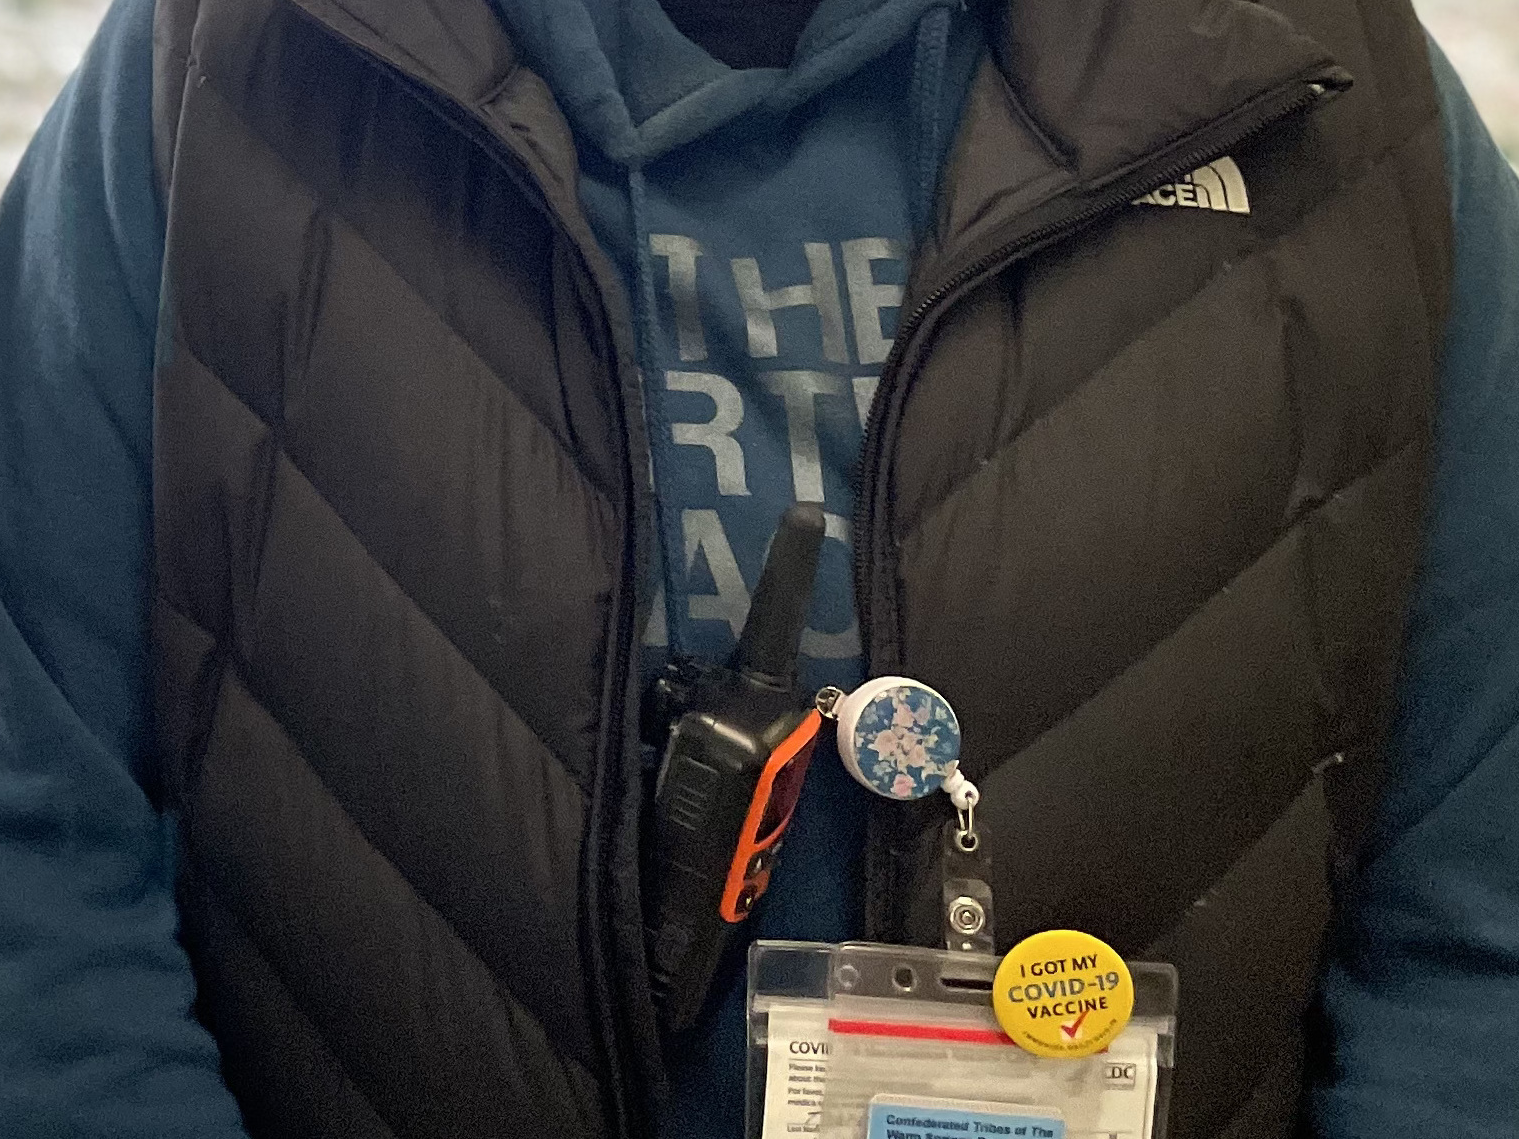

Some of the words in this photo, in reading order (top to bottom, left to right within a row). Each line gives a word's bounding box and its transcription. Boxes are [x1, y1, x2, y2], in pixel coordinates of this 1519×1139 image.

[649, 232, 905, 364] THE
[1020, 964, 1026, 978] I
[1031, 959, 1067, 976] GOT
[1072, 954, 1098, 971] MY
[1008, 971, 1120, 1003] COVID-19
[1027, 996, 1109, 1019] VACCINE
[789, 1041, 829, 1055] COVI
[1105, 1066, 1135, 1079] DC
[887, 1114, 970, 1131] Confederated
[974, 1121, 1011, 1134] Tribes
[1015, 1126, 1028, 1136] of
[1032, 1126, 1054, 1138] The
